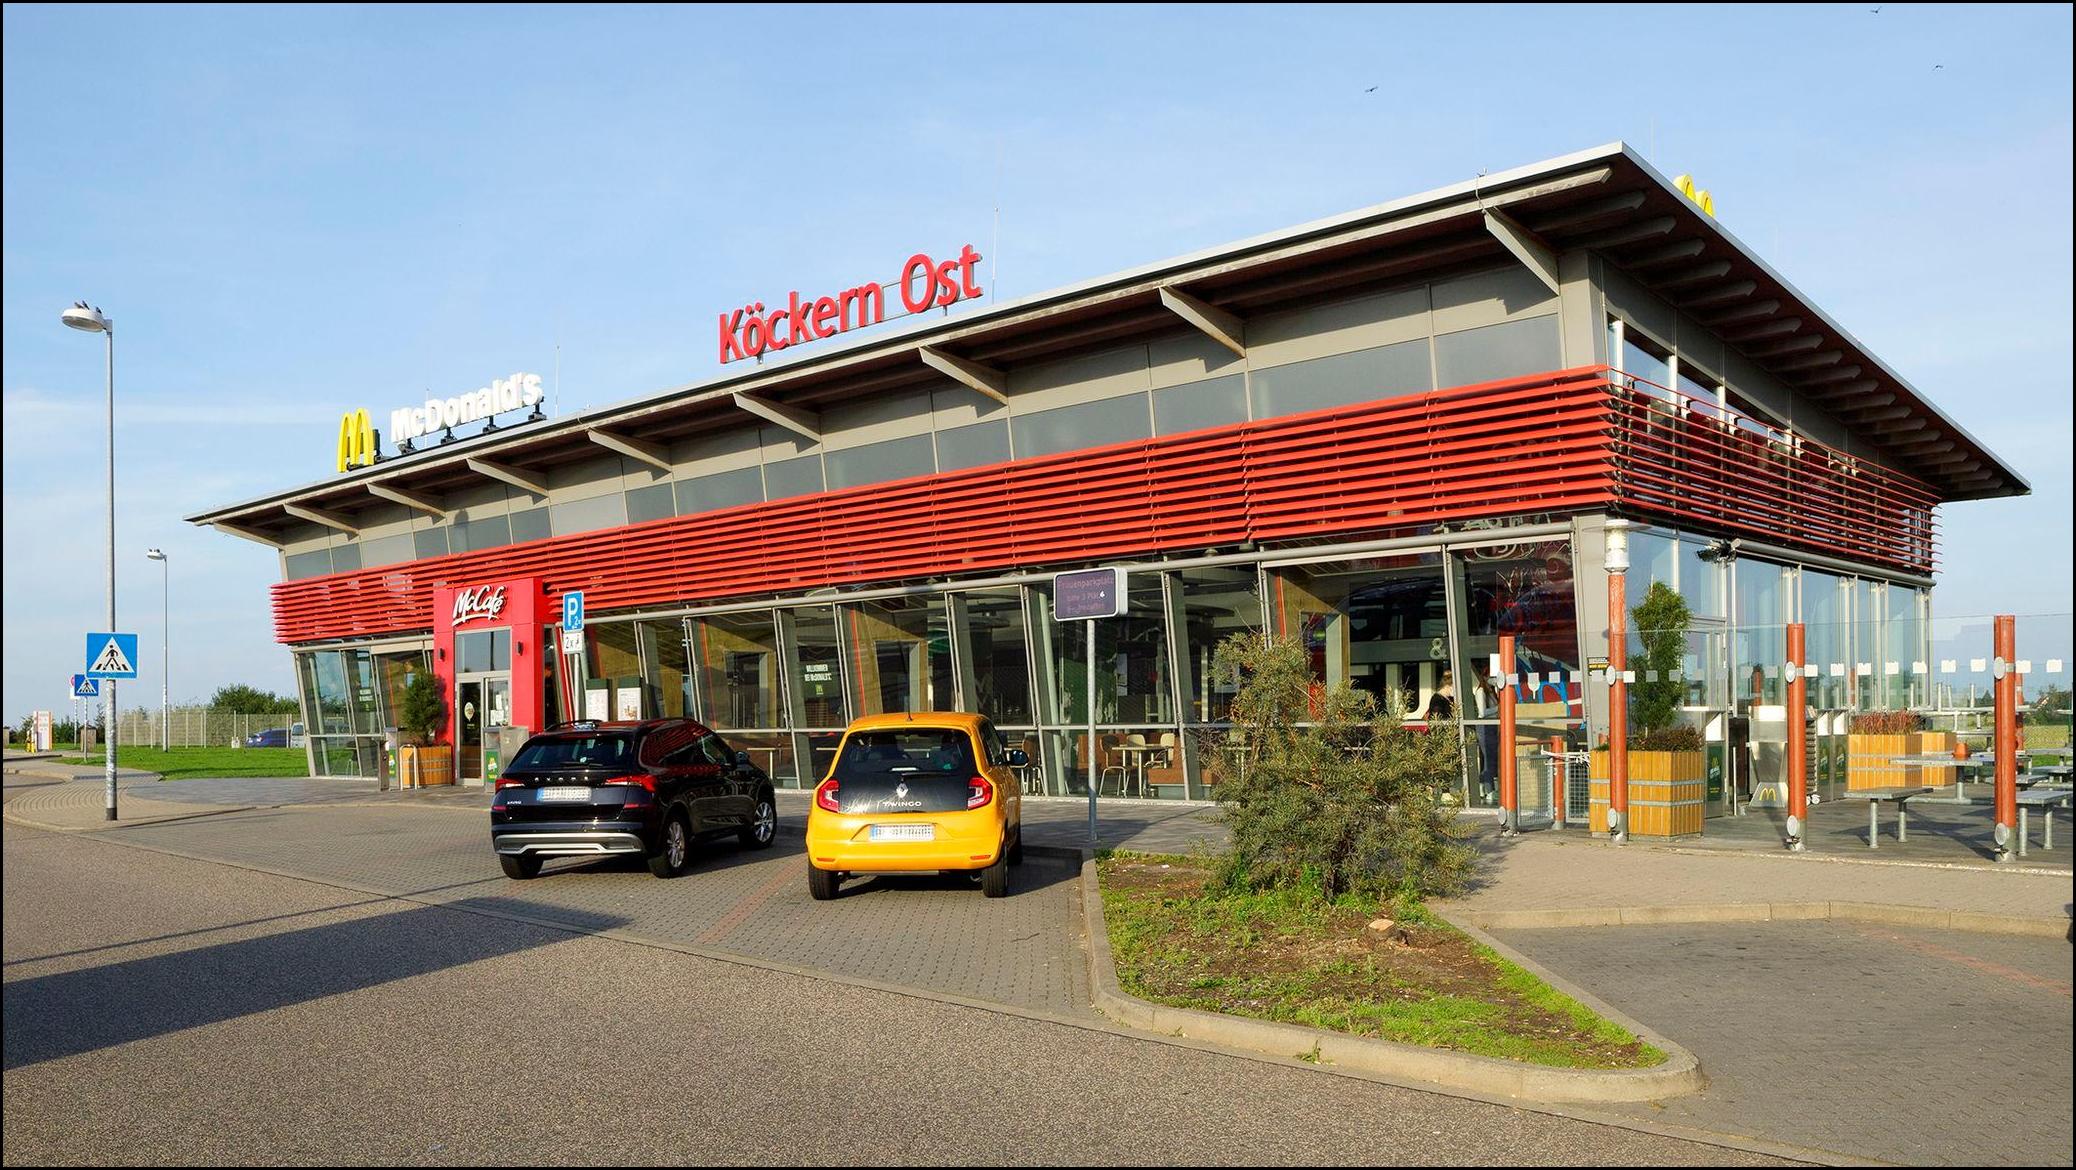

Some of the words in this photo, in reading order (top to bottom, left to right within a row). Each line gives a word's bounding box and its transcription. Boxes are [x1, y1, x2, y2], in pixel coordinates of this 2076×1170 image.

[719, 281, 883, 364] Köckern
[901, 244, 983, 313] Ost
[391, 372, 543, 443] McDonald's
[452, 585, 505, 623] McCafé
[567, 597, 579, 626] P
